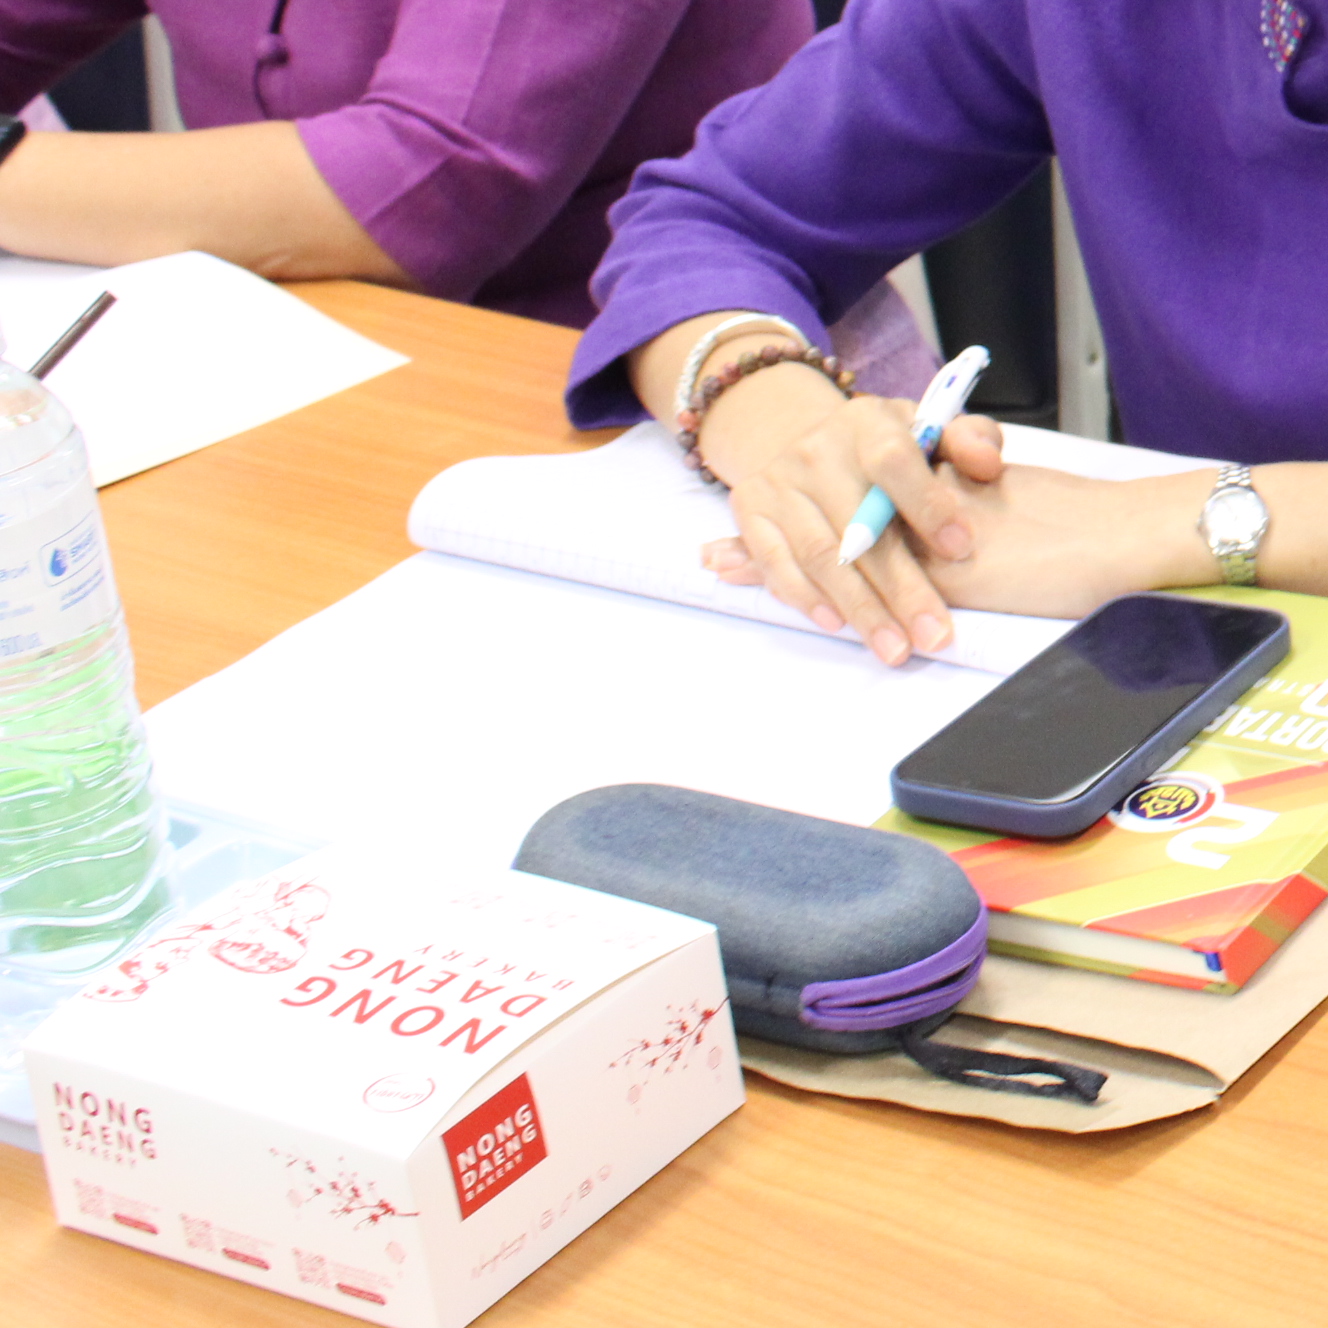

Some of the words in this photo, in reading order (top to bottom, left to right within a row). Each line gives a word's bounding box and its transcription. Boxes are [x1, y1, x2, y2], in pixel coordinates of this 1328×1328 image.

[328, 948, 549, 1018] DAENG
[414, 944, 576, 991] BAKERY
[279, 976, 509, 1055] NONG
[53, 1081, 154, 1135] NONG
[58, 1110, 158, 1161] DAENG
[456, 1103, 534, 1173] NONG
[460, 1123, 538, 1191] DAENG
[465, 1152, 524, 1203] BAKERY
